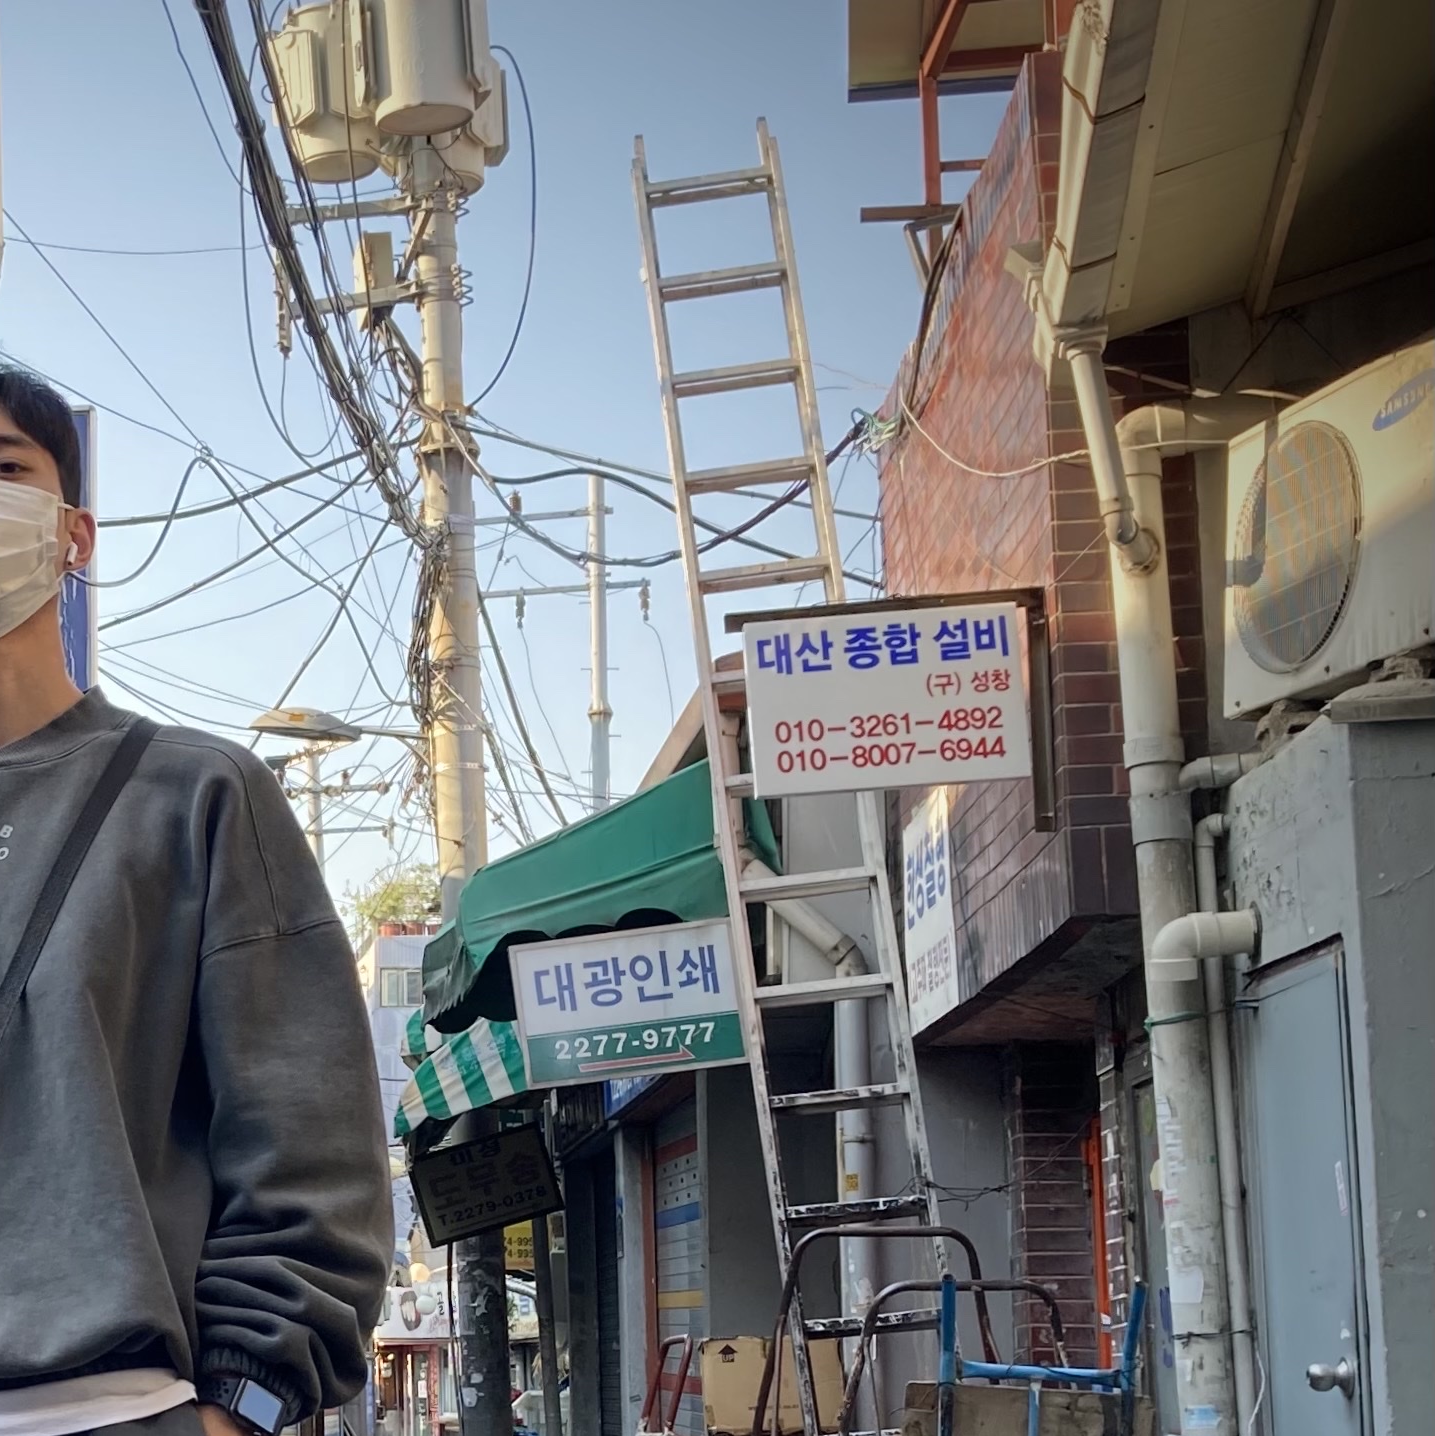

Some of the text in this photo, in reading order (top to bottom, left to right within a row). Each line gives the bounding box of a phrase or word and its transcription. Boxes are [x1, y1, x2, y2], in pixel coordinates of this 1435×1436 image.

[756, 615, 1010, 675] 대산 종합 설비
[926, 669, 1011, 697] (구) 성창
[775, 706, 1004, 743] 010-3261-4892
[777, 736, 1006, 773] 010-8007-6944
[533, 945, 720, 1012] 대광인쇄
[554, 1021, 715, 1060] 2277-9777
[722, 1354, 735, 1362] UP
